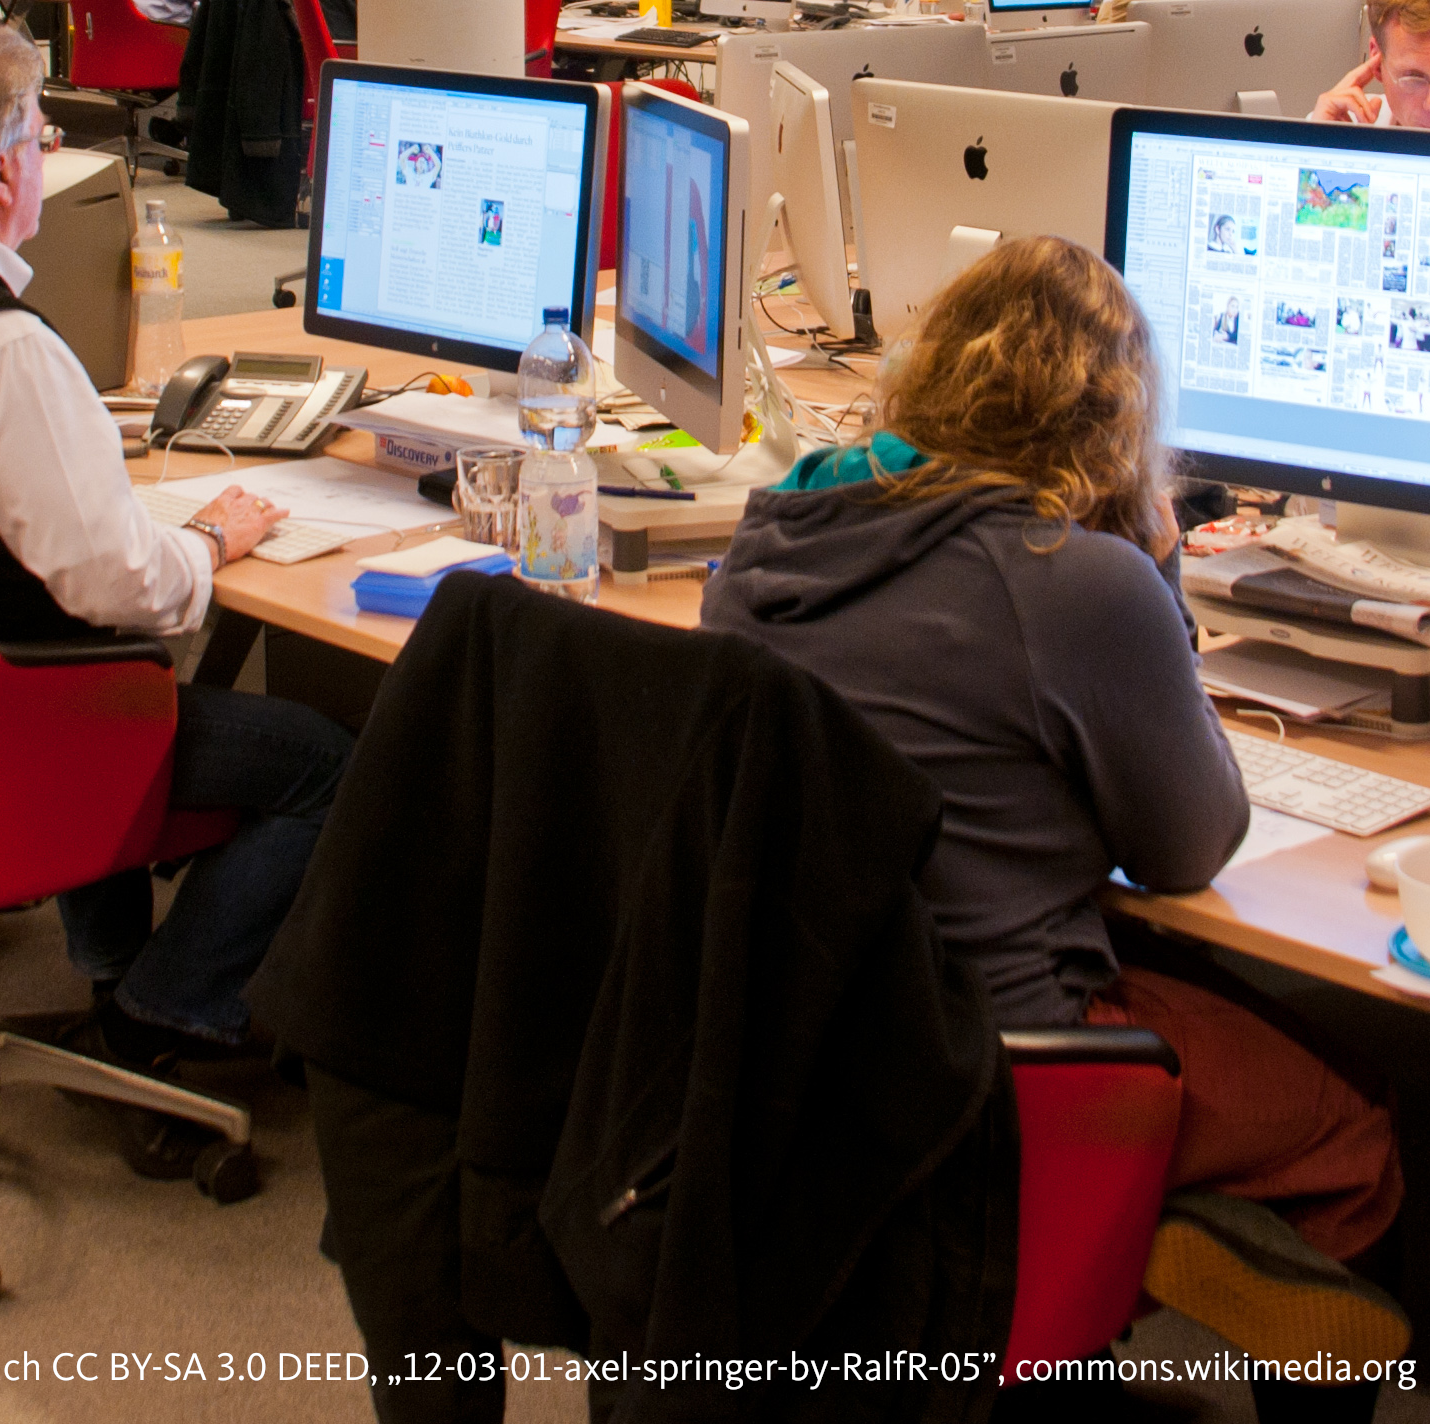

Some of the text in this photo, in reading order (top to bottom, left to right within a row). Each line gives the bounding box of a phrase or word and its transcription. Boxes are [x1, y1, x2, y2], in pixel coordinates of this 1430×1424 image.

[448, 127, 533, 146] Kein Biathlon-Gold durch
[473, 143, 495, 156] Patzer
